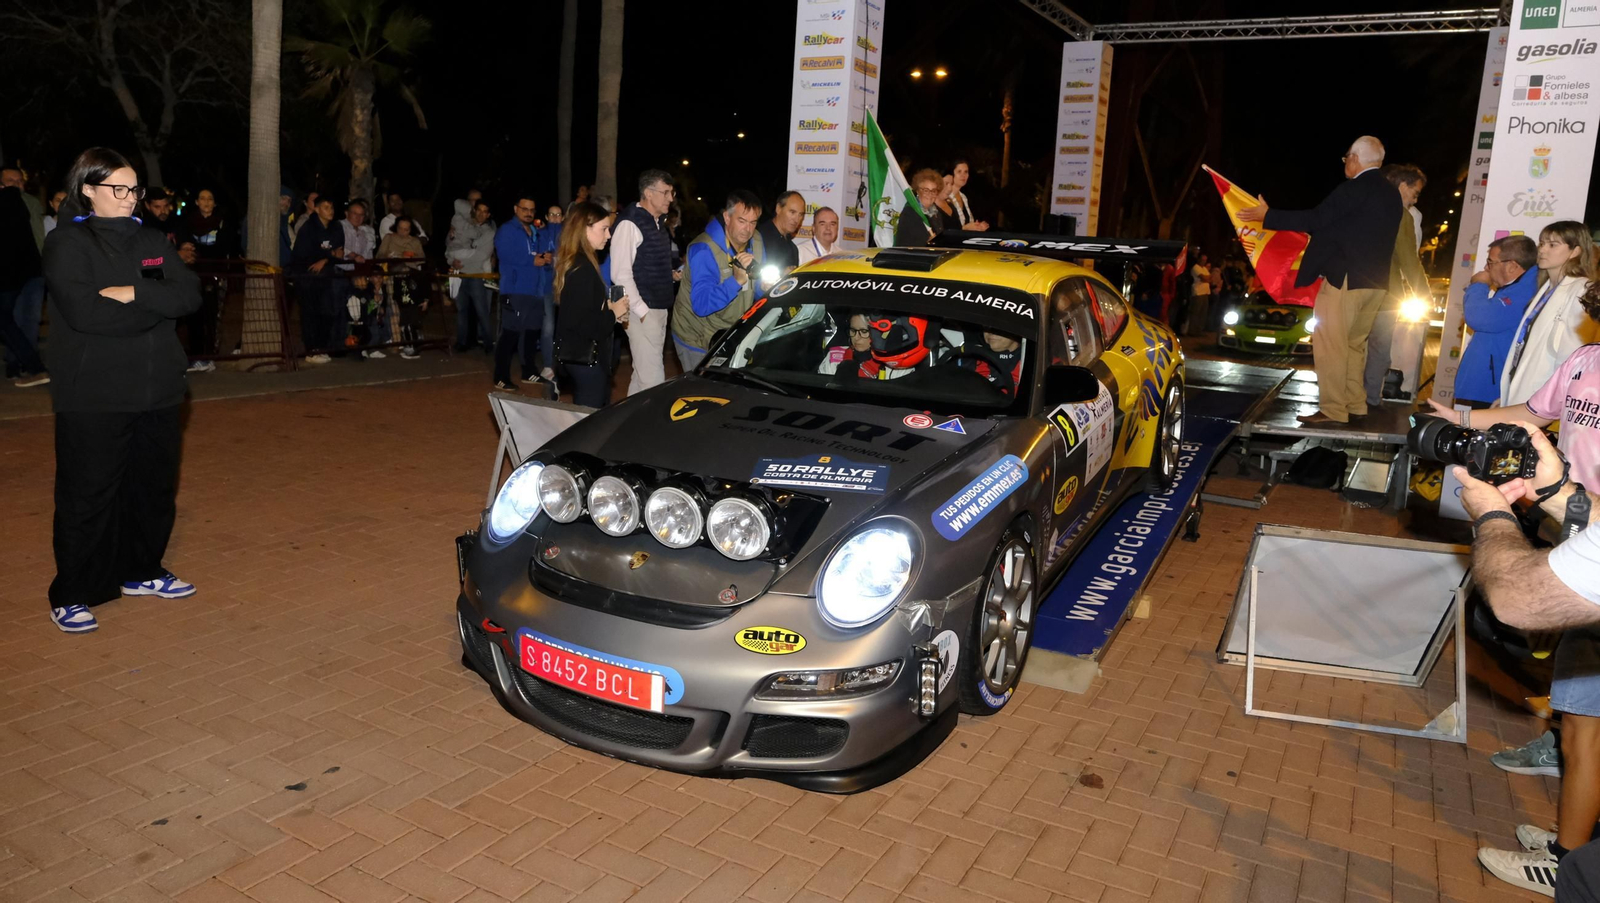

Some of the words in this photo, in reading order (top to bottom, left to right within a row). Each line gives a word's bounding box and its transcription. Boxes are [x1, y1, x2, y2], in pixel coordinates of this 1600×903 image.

[1525, 6, 1557, 18] UNED
[1516, 38, 1598, 62] gasolia
[1544, 81, 1590, 90] Fornieles
[1543, 91, 1551, 100] &
[1554, 91, 1589, 100] albesa
[1507, 116, 1586, 134] Phonika
[799, 278, 896, 292] AUTOMÓVIL
[900, 283, 948, 298] CLUB
[950, 290, 1035, 320] ALMERÍA
[733, 405, 937, 452] SORT
[1057, 415, 1075, 447] 8
[781, 432, 824, 446] RACING
[827, 440, 909, 465] TECHNOLOGY
[818, 456, 831, 464] 8
[765, 464, 793, 472] 50
[793, 465, 877, 478] RALLYE
[819, 474, 873, 484] ALMERÍA
[939, 505, 958, 520] TUS
[954, 482, 986, 509] PEDIDOS
[981, 474, 995, 487] EN
[989, 468, 1003, 479] UN
[998, 459, 1014, 473] CLIC
[948, 468, 1023, 532] www.emmex.es
[743, 629, 800, 644] auto
[769, 642, 797, 653] gar
[526, 645, 536, 667] S
[541, 651, 588, 687] 8452
[595, 668, 640, 701] BCL
